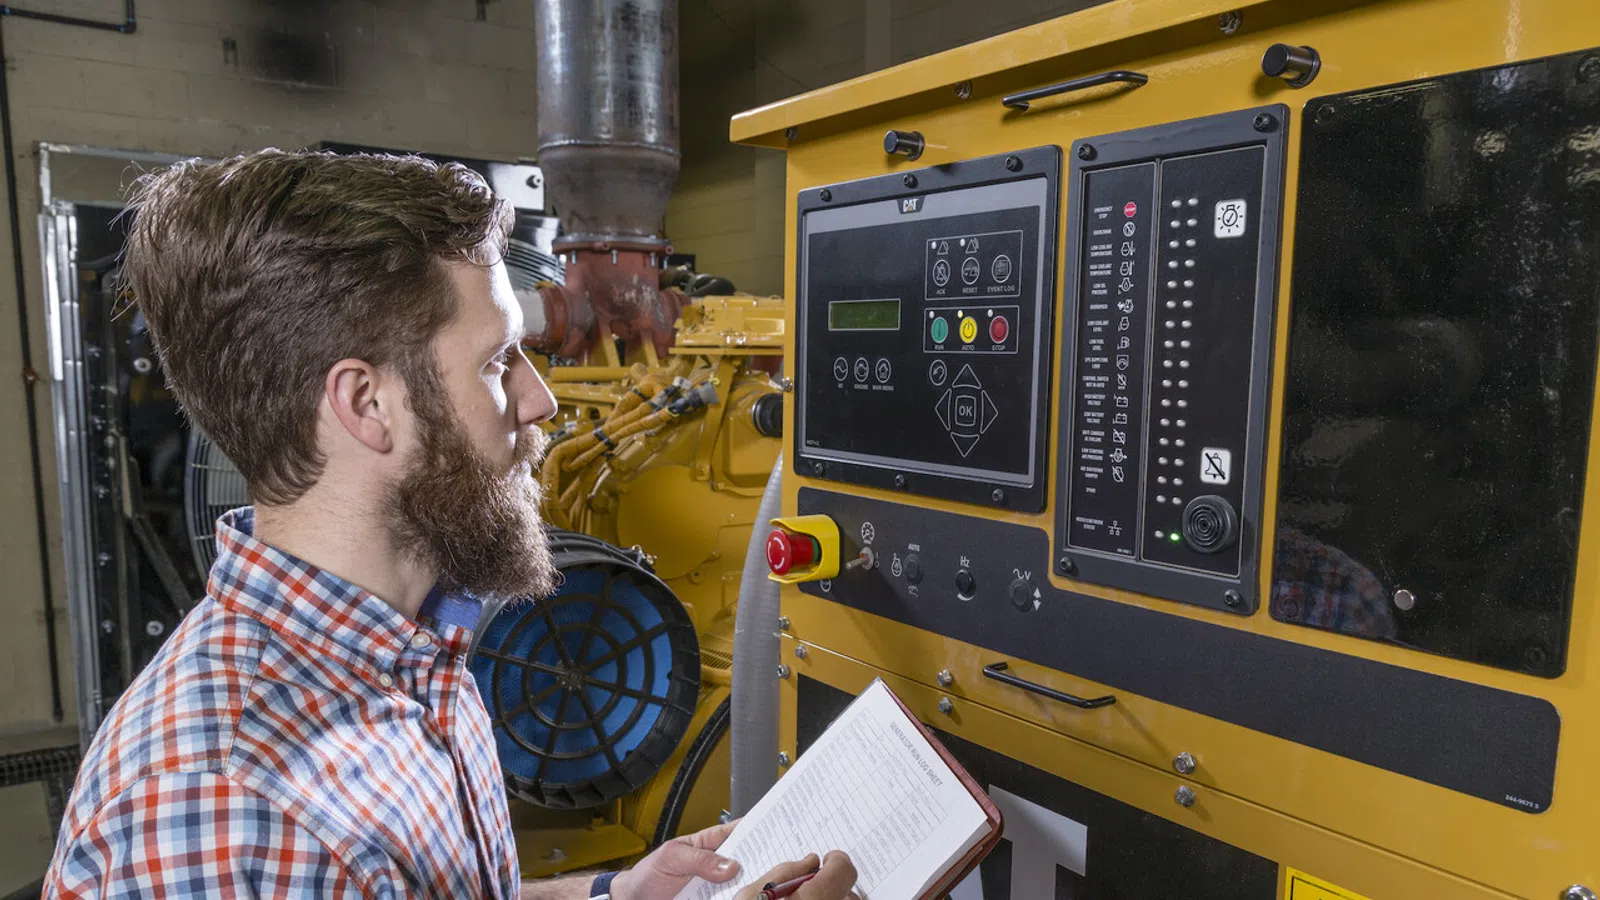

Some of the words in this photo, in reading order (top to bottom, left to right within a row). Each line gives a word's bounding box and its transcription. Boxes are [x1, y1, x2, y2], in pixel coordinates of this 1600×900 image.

[903, 198, 919, 213] CAT
[958, 405, 973, 418] OK
[908, 543, 920, 552] AUTO
[960, 555, 970, 568] Hz
[890, 722, 913, 751] GENERATOR
[911, 748, 921, 761] RUN
[917, 758, 929, 772] LOG
[926, 768, 943, 787] SHEET
